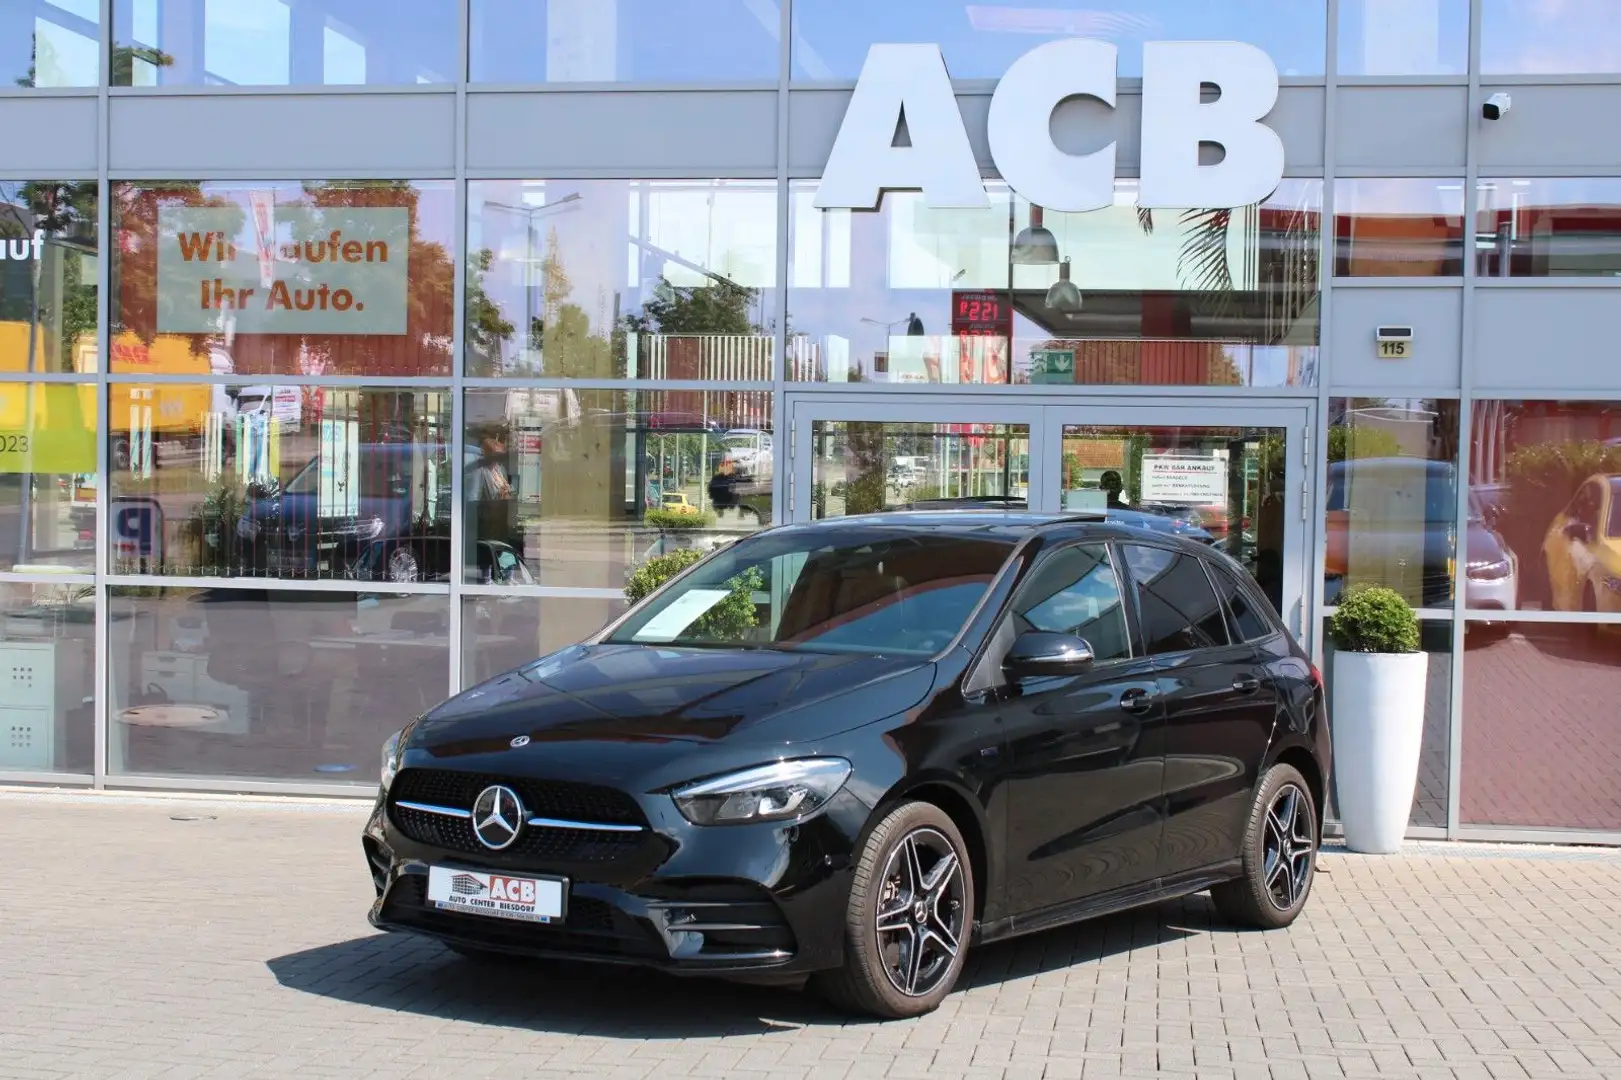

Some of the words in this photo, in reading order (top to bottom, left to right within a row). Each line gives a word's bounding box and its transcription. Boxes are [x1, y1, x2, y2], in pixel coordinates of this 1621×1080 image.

[813, 38, 1285, 212] ACB
[177, 231, 237, 262] Wir
[258, 230, 389, 263] aufen
[201, 278, 254, 310] Ihr
[265, 280, 364, 311] Auto.
[1381, 342, 1405, 355] 115
[448, 895, 467, 904] AUTO
[470, 898, 496, 908] CENTER
[499, 902, 536, 913] BIESDORF
[490, 878, 536, 903] ACB
